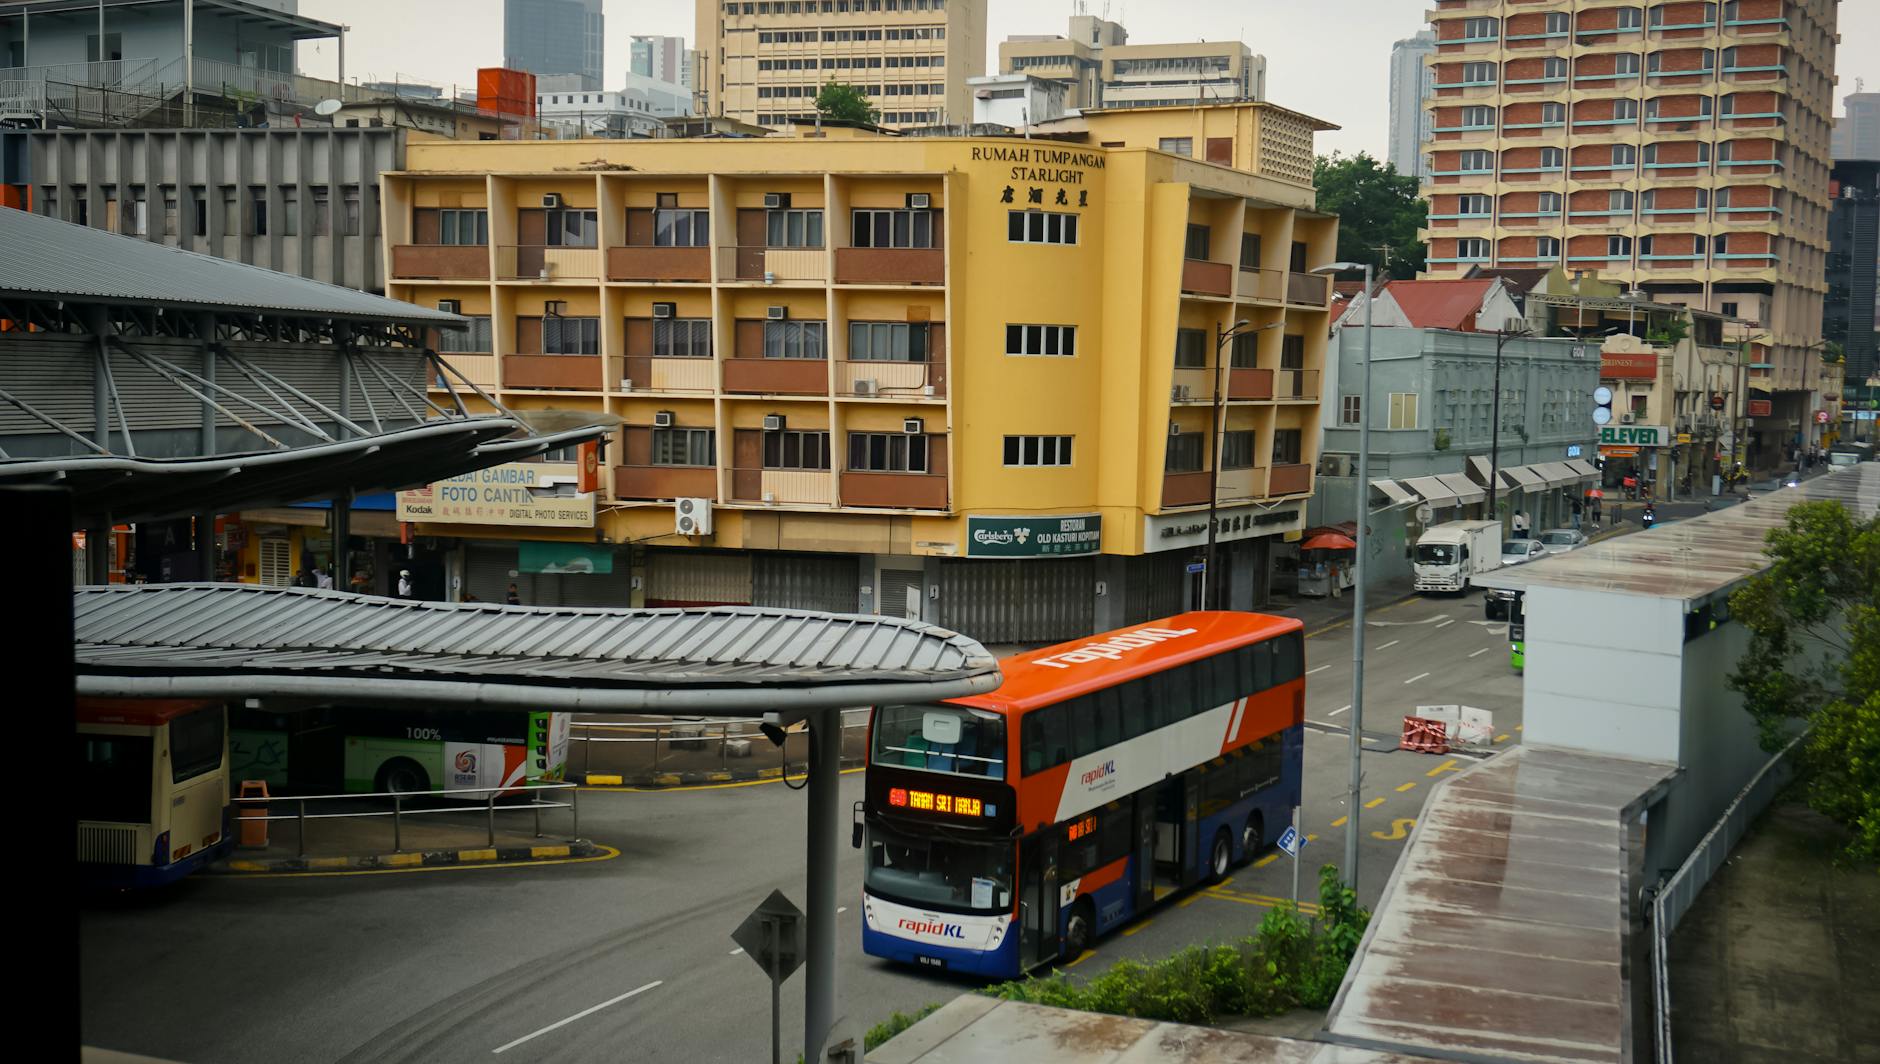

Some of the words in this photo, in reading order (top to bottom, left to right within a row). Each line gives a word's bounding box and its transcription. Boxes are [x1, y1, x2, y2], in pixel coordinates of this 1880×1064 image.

[972, 147, 1029, 162] RUMAH
[1034, 149, 1105, 168] TUMPANGAN
[1011, 167, 1084, 184] STARLIGHT
[482, 470, 535, 485] GAMBAR
[441, 487, 478, 502] FOTO
[483, 487, 534, 503] CANTIK
[406, 504, 432, 514] Kodak
[509, 509, 533, 519] DIGITAL
[535, 510, 555, 520] PHOTO
[558, 511, 588, 521] SERVICES
[974, 528, 1013, 544] Carlsberg
[1037, 533, 1051, 544] OLD
[1052, 531, 1078, 543] KASTURI
[1032, 627, 1198, 669] rapidKL
[406, 727, 442, 741] 100%
[1081, 760, 1116, 785] rapidKL
[909, 790, 934, 810] TAMAN
[936, 794, 952, 813] SRI
[898, 918, 966, 939] rapidKL
